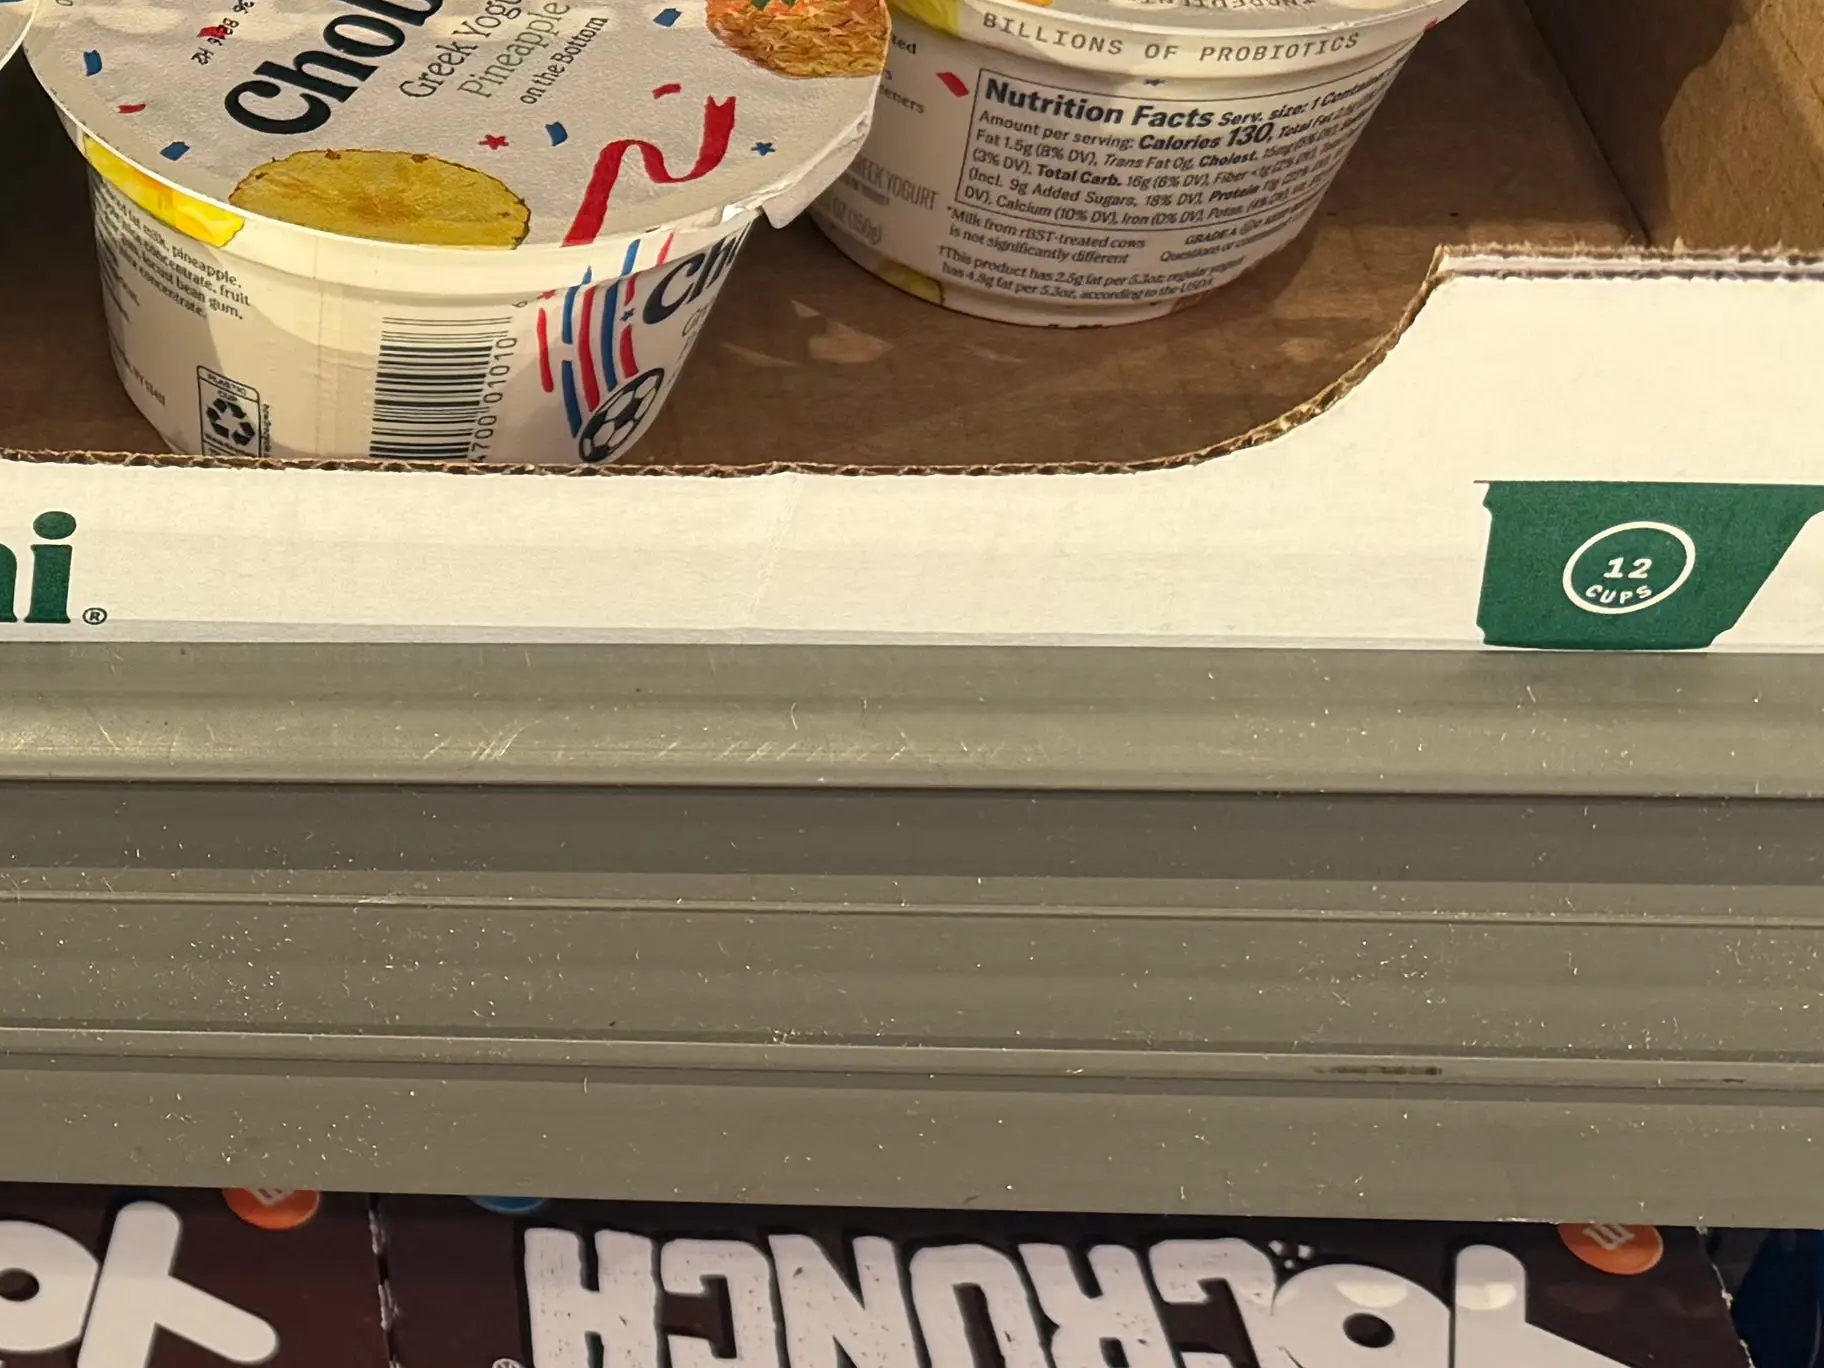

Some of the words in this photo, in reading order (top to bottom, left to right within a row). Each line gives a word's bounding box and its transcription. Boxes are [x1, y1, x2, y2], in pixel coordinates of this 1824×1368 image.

[457, 1, 571, 99] Pineapple
[982, 12, 1123, 56] BILLIONS
[1144, 43, 1179, 60] OF
[1199, 33, 1359, 62] PROBIOTICS
[399, 41, 479, 98] Greek
[520, 84, 546, 105] on
[534, 63, 566, 87] the
[551, 17, 609, 65] Bottom
[985, 79, 1123, 125] Nutrition
[1131, 105, 1215, 128] Facts
[1219, 110, 1264, 126] Serv.
[1269, 102, 1309, 120] size:
[976, 129, 1000, 147] Fat
[1004, 136, 1035, 157] 1.5g
[979, 110, 1040, 136] Amount
[1043, 127, 1069, 141] per
[1073, 131, 1134, 150] serving:
[1139, 135, 1221, 149] Calories
[1226, 123, 1273, 147] 130,
[996, 193, 1052, 218] Calcium
[1032, 182, 1082, 202] Added
[1083, 190, 1138, 208] Sugars,
[220, 284, 250, 306] fruit
[1603, 557, 1652, 579] 12
[1585, 584, 1652, 604] CUPS
